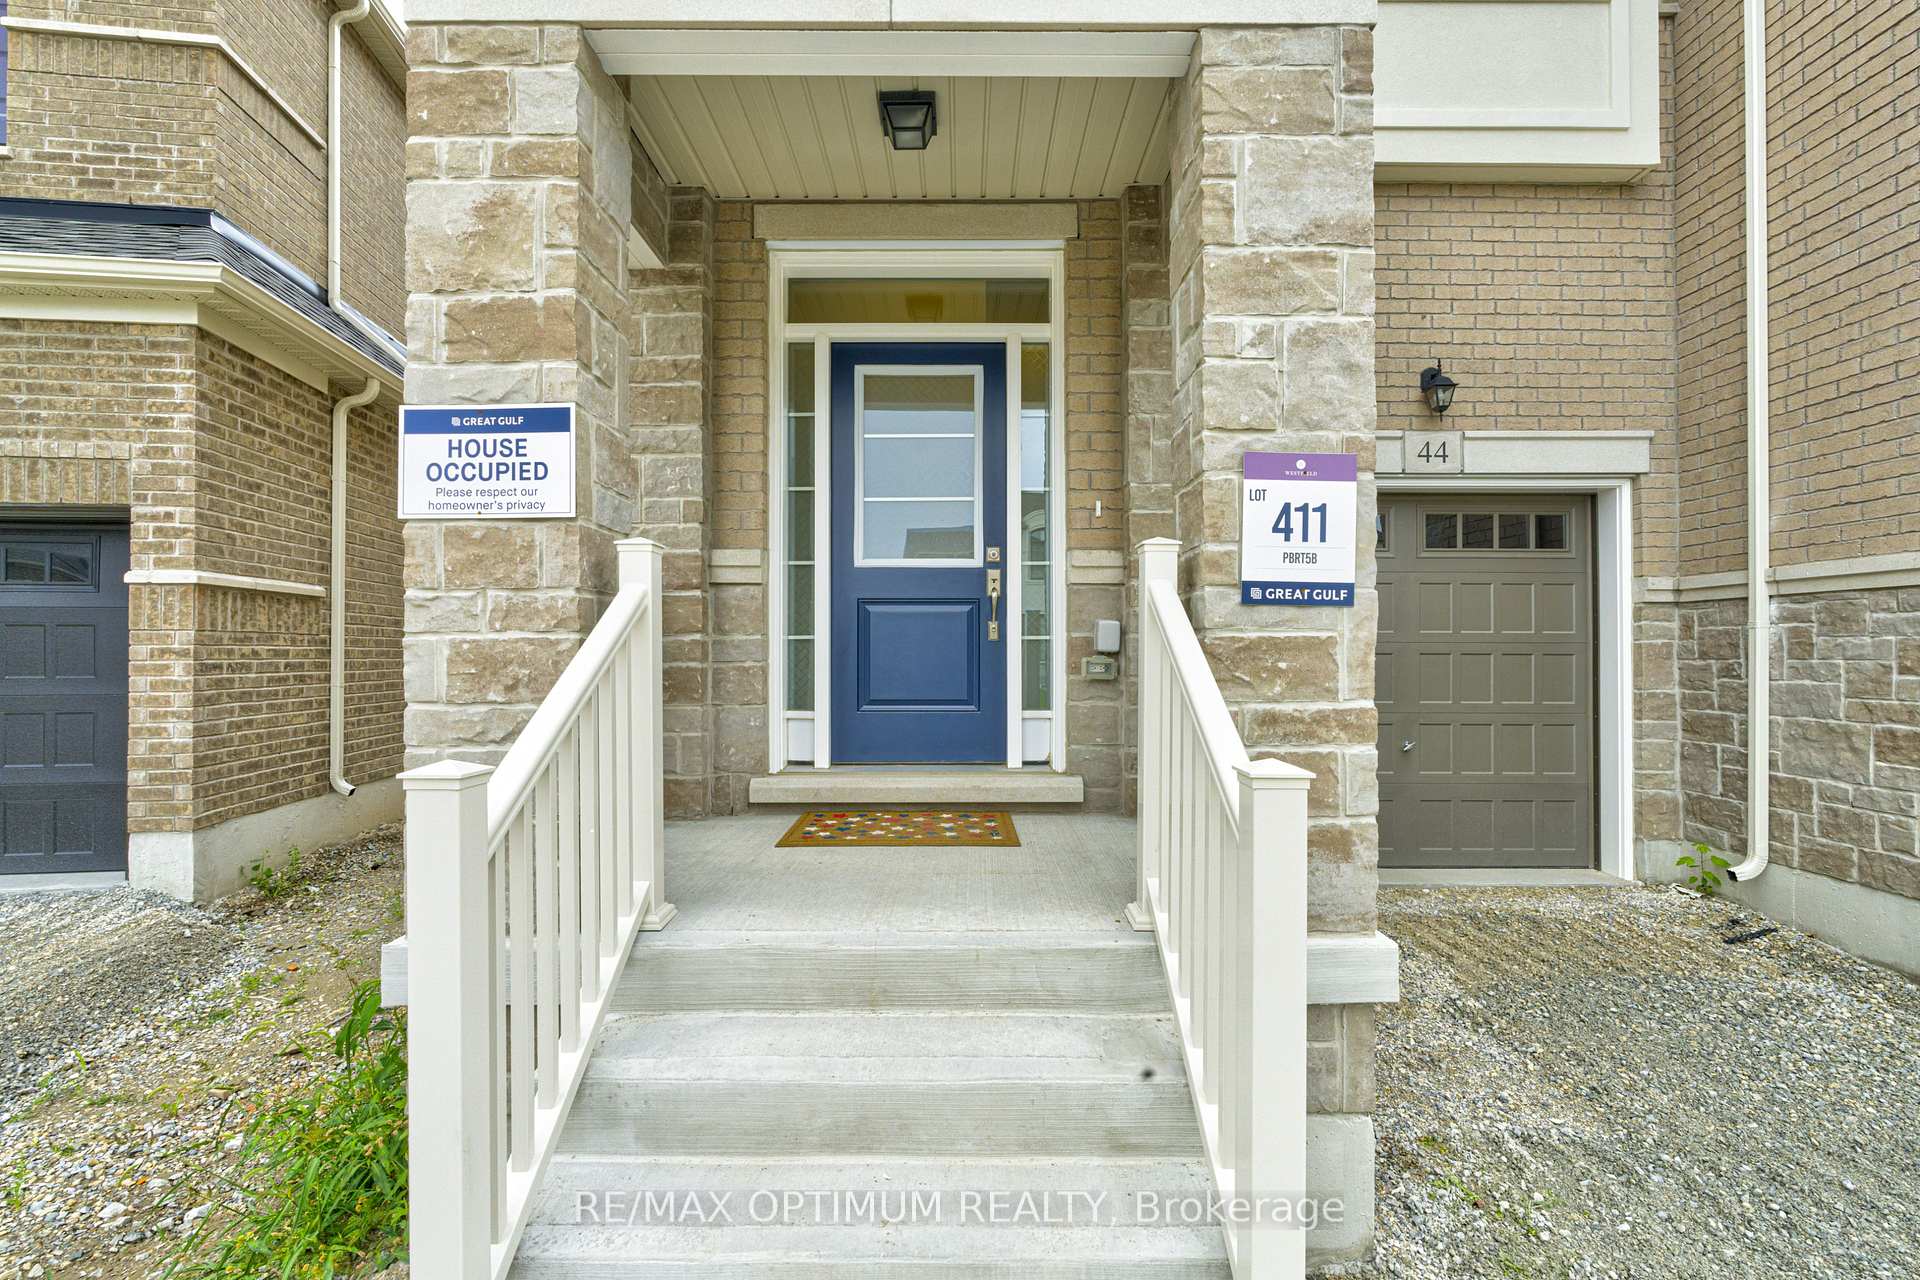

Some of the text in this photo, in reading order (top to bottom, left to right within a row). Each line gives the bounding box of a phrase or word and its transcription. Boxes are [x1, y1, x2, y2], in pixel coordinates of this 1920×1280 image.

[463, 416, 524, 426] GREAT GULF
[448, 438, 528, 458] HOUSE
[1417, 441, 1449, 463] 44
[426, 461, 548, 482] OCCUPIED
[436, 487, 538, 499] Please respect our
[1249, 489, 1267, 502] LOT
[428, 500, 546, 512] homeowner's privacy
[1271, 502, 1327, 543] 411
[1282, 552, 1318, 564] PBRT5B
[1265, 588, 1348, 601] GREAT GULF
